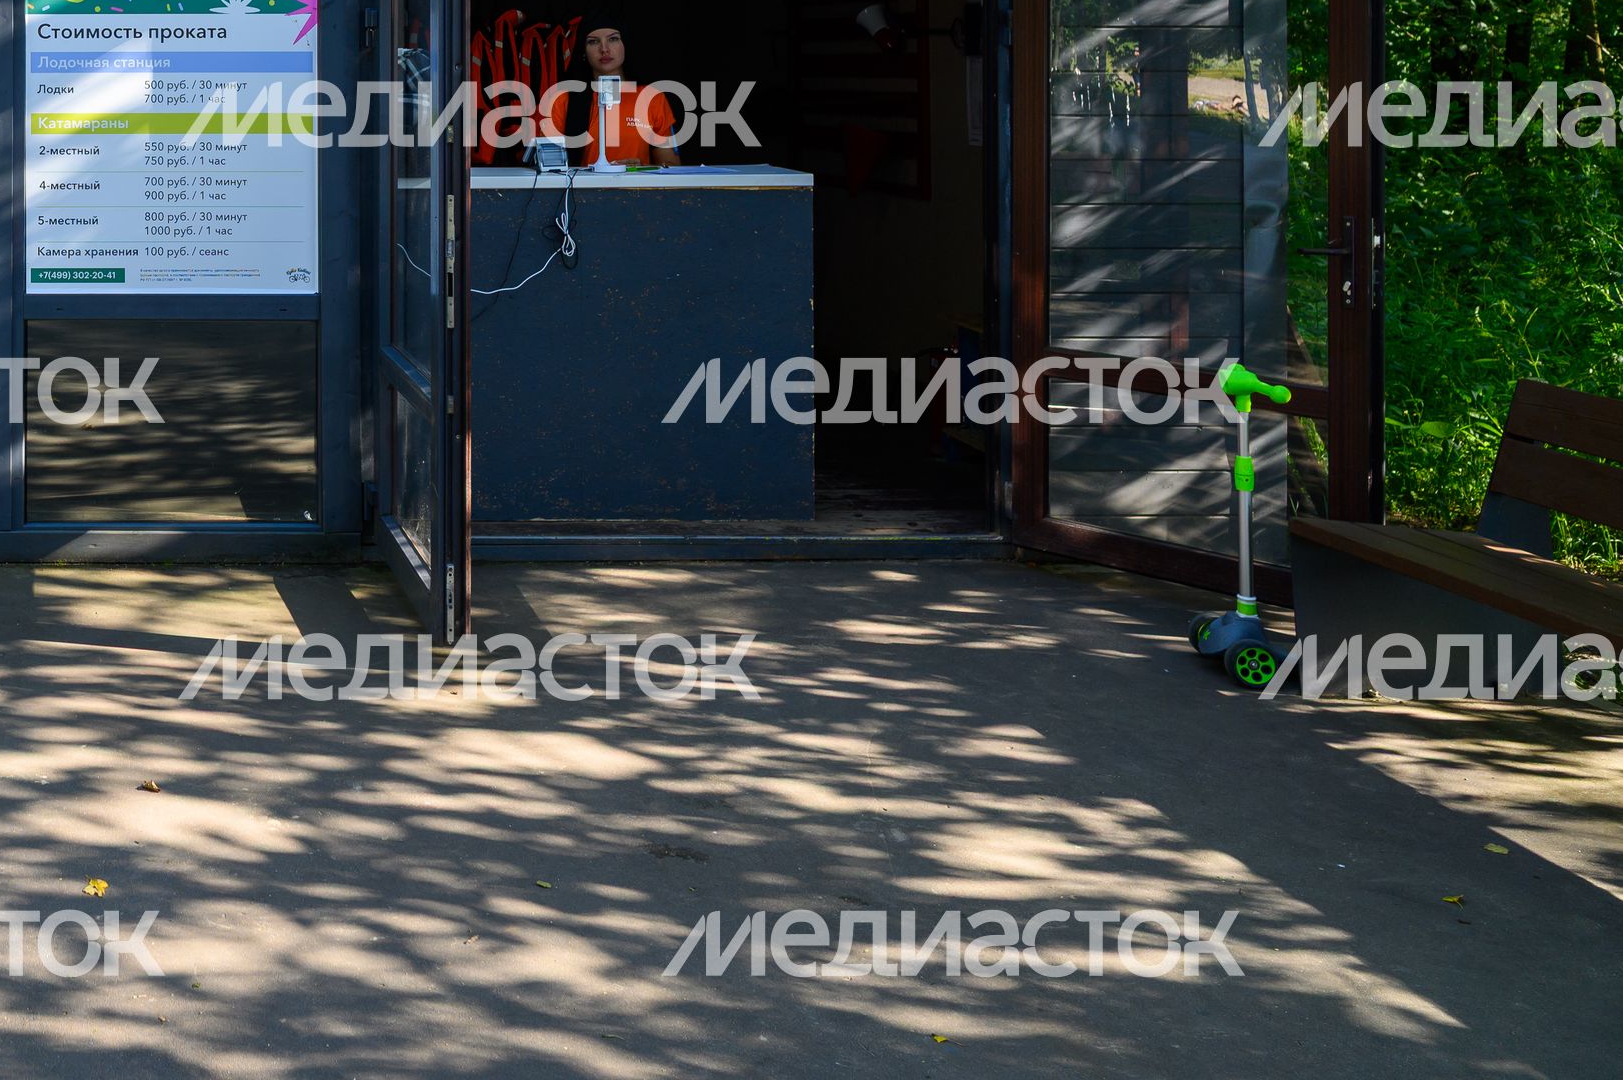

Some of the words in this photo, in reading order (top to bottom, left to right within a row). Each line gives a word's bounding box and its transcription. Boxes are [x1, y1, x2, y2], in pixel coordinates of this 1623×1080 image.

[37, 23, 143, 40] Стоимость
[148, 26, 227, 42] проката
[37, 56, 109, 70] Лодочная
[113, 58, 171, 70] станция
[37, 84, 75, 96] Лодки
[144, 80, 165, 90] 500
[167, 80, 190, 93] руб.
[199, 80, 212, 90] 30
[215, 82, 247, 93] минут
[144, 94, 165, 104] 700
[167, 94, 190, 107] руб.
[208, 96, 226, 104] час
[38, 117, 129, 132] Катамараны
[39, 144, 100, 156] 2-местный
[144, 142, 165, 152] 550
[167, 142, 190, 155] руб.
[199, 142, 212, 152] 30
[215, 144, 247, 155] минут
[144, 156, 165, 166] 750
[167, 156, 190, 169] руб.
[208, 158, 226, 166] час
[39, 180, 101, 191] 4-местный
[144, 177, 165, 187] 700
[167, 177, 190, 190] руб.
[199, 177, 212, 187] 30
[215, 179, 247, 190] минут
[144, 191, 165, 201] 900
[167, 191, 190, 204] руб.
[37, 214, 99, 226] 5-местный
[144, 212, 165, 222] 800
[167, 212, 190, 225] руб.
[199, 212, 212, 222] 30
[215, 214, 247, 225] минут
[144, 226, 171, 236] 1000
[173, 226, 197, 239] руб.
[215, 228, 233, 236] час
[37, 246, 82, 258] Камера
[85, 248, 139, 259] хранения
[145, 246, 165, 256] 100
[167, 246, 190, 260] руб.
[199, 248, 229, 256] сеанс
[38, 270, 71, 281] +7(499)
[73, 270, 117, 280] 302-20-41
